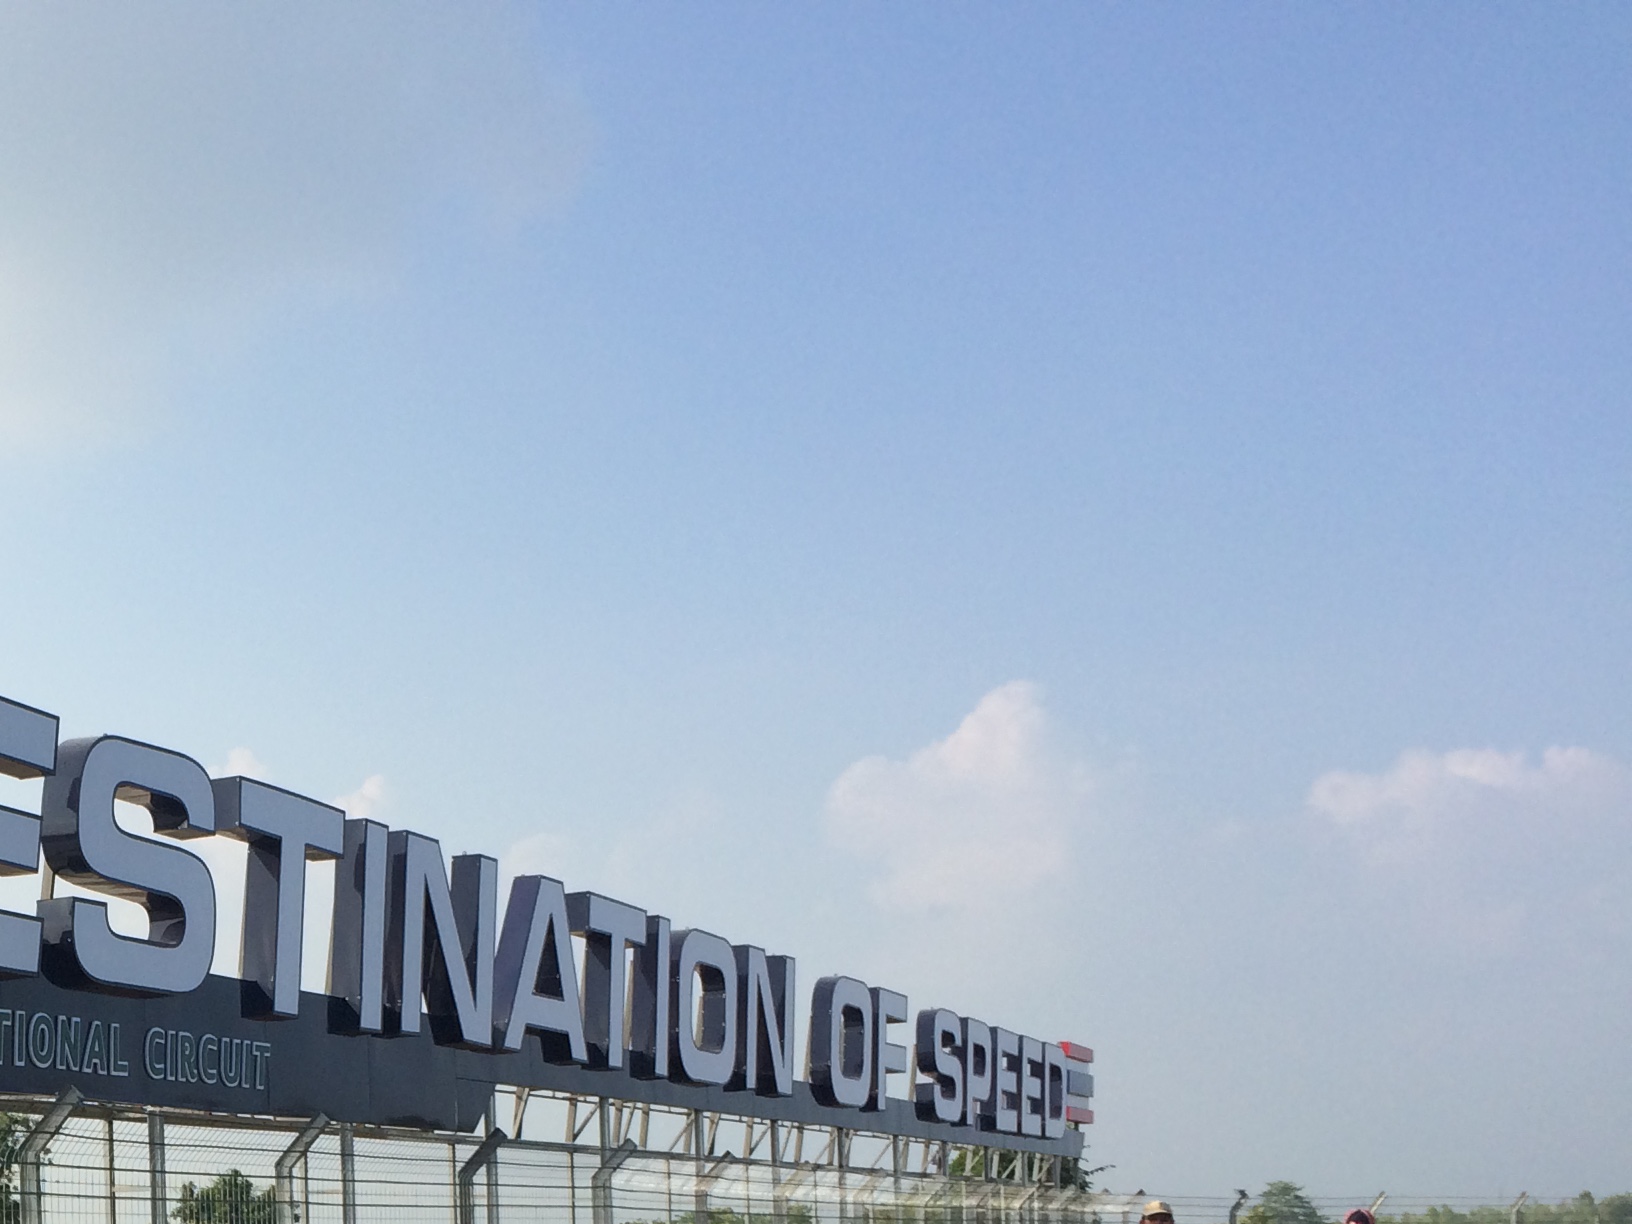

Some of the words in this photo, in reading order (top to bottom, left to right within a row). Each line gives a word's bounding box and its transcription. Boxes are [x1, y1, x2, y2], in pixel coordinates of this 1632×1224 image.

[144, 1027, 272, 1090] CIRCUIT
[820, 974, 909, 1111] OF
[925, 1007, 1069, 1140] SPEED
